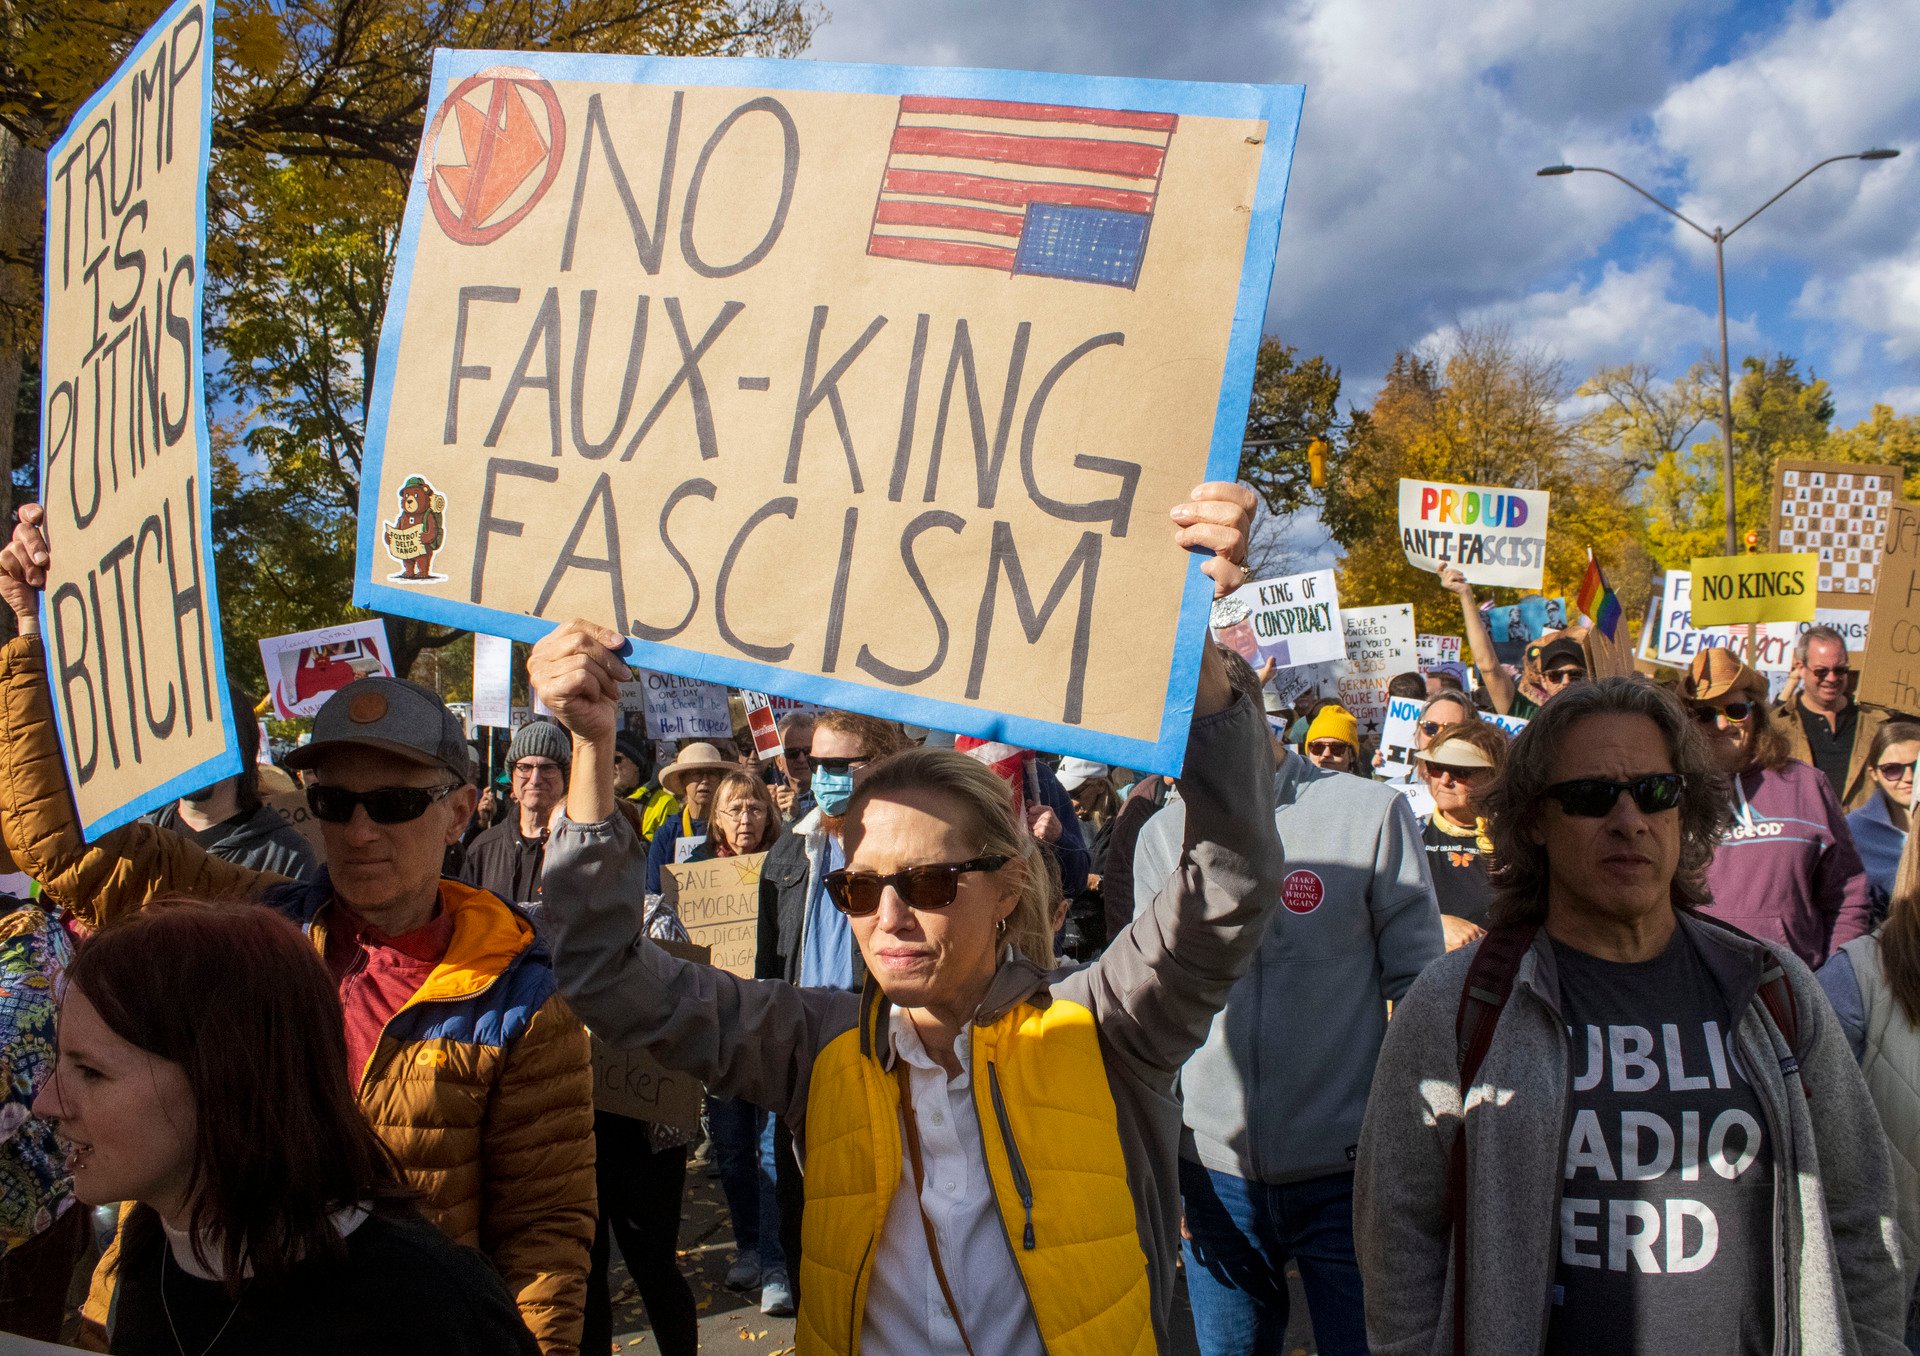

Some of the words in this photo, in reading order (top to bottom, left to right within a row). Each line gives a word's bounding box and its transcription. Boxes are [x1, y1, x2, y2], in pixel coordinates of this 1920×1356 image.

[56, 7, 202, 291] TRUMP
[560, 90, 800, 278] NO
[83, 202, 148, 360] IS
[444, 286, 1142, 538] FAUX-KING
[1420, 487, 1529, 528] PROUD
[390, 530, 419, 541] FOXTROT
[395, 540, 415, 548] DELTA
[396, 546, 418, 554] TANGO
[1403, 527, 1547, 569] ANTI-FASCIST
[470, 457, 1103, 725] FASCISM
[1259, 582, 1294, 606] KING
[1302, 577, 1317, 599] OF
[1703, 574, 1733, 601] NO
[1738, 570, 1805, 599] KINGS
[52, 476, 213, 788] BITCH
[1254, 602, 1333, 638] CONSPIRACY
[1347, 618, 1376, 628] EVER
[1346, 640, 1361, 649] HAT
[1366, 639, 1391, 647] YOU'D
[1361, 650, 1384, 660] DONE
[1389, 648, 1401, 658] IN
[649, 702, 667, 714] and
[711, 699, 721, 710] be
[659, 690, 678, 700] one
[683, 689, 699, 698] DAY
[661, 717, 685, 734] Hell
[674, 869, 722, 892] SAVE
[1291, 876, 1315, 884] MAKE
[1286, 891, 1318, 900] WRONG
[1565, 1107, 1763, 1182] ADIO
[1560, 1198, 1720, 1275] ERD
